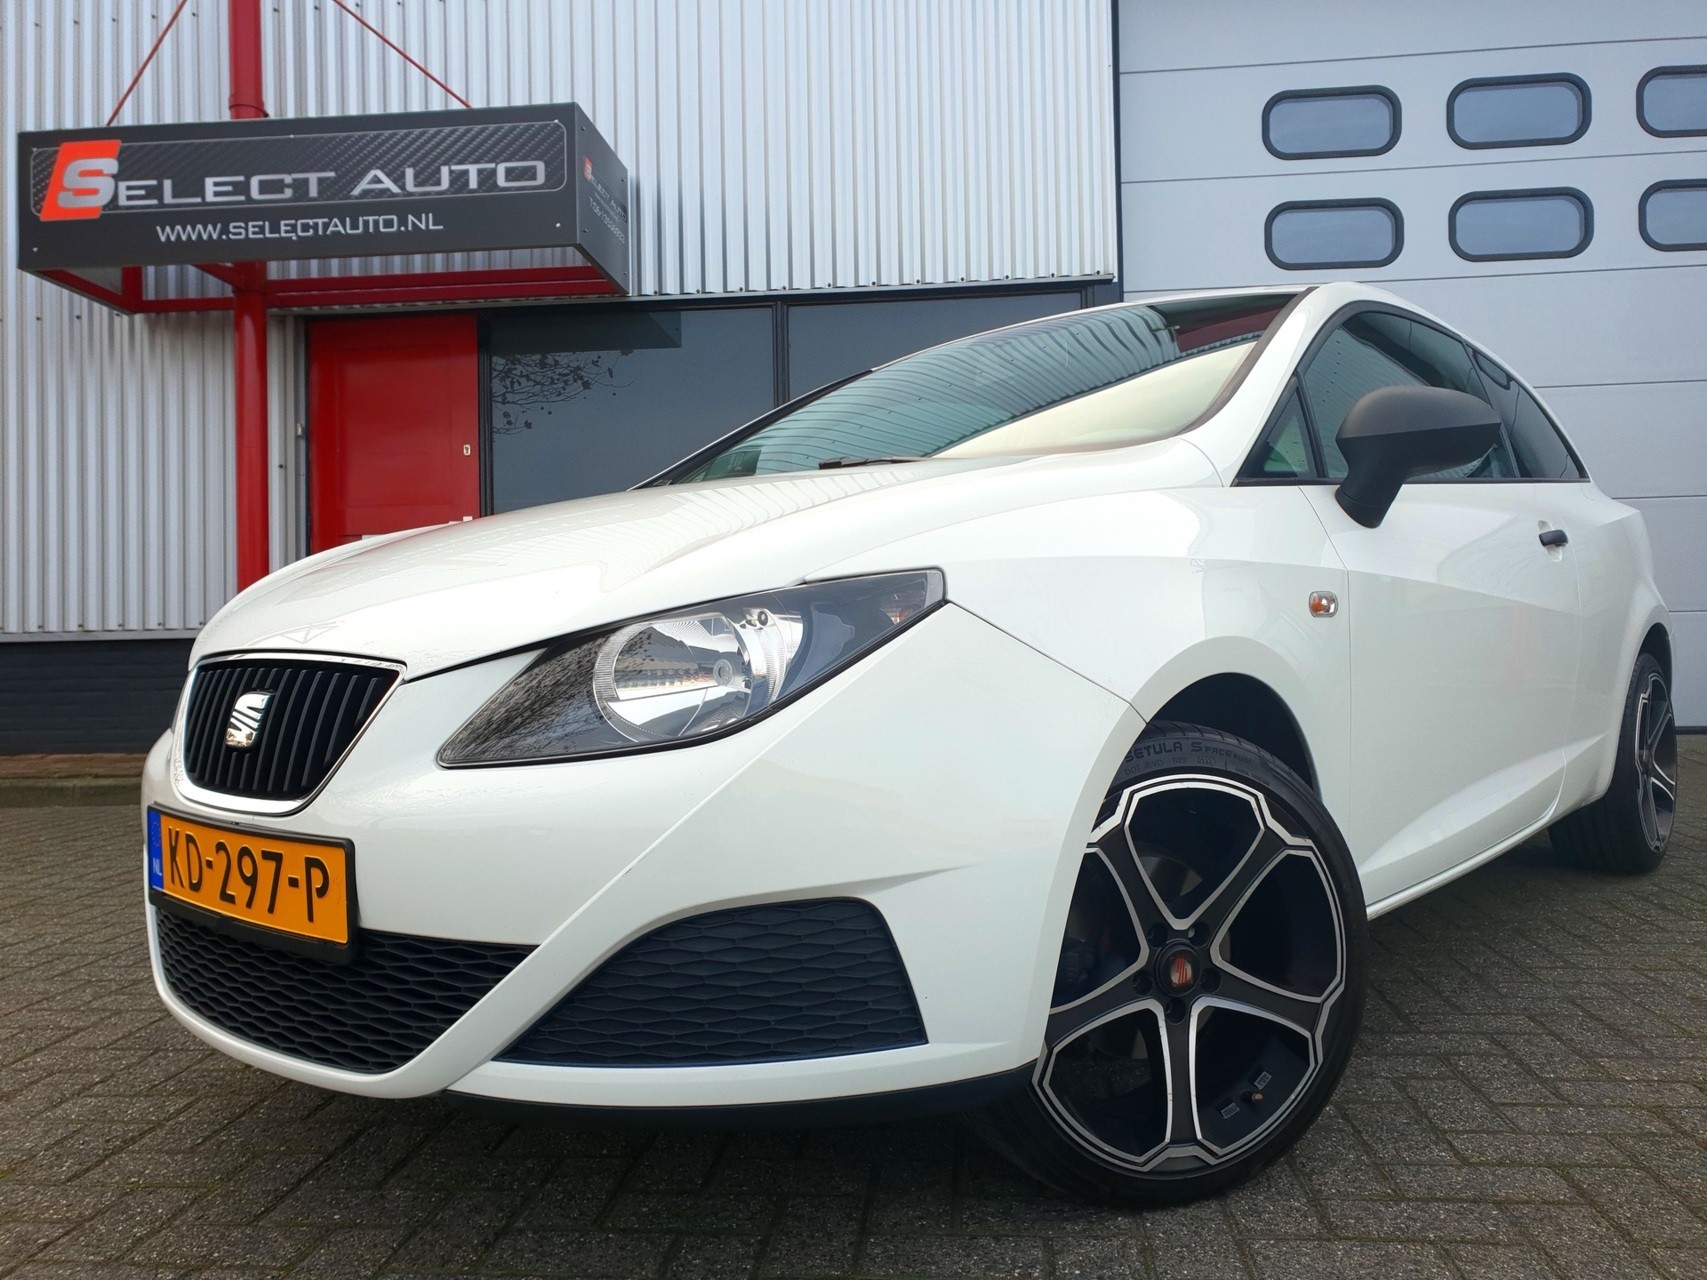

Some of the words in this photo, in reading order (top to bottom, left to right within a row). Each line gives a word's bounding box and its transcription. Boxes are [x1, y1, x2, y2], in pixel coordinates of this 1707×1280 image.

[57, 157, 335, 208] SELECT
[350, 160, 546, 196] AUTO
[156, 214, 444, 243] WWW.SELECTAUTO.NL
[152, 857, 163, 877] NL
[168, 826, 330, 923] KD-297-P
